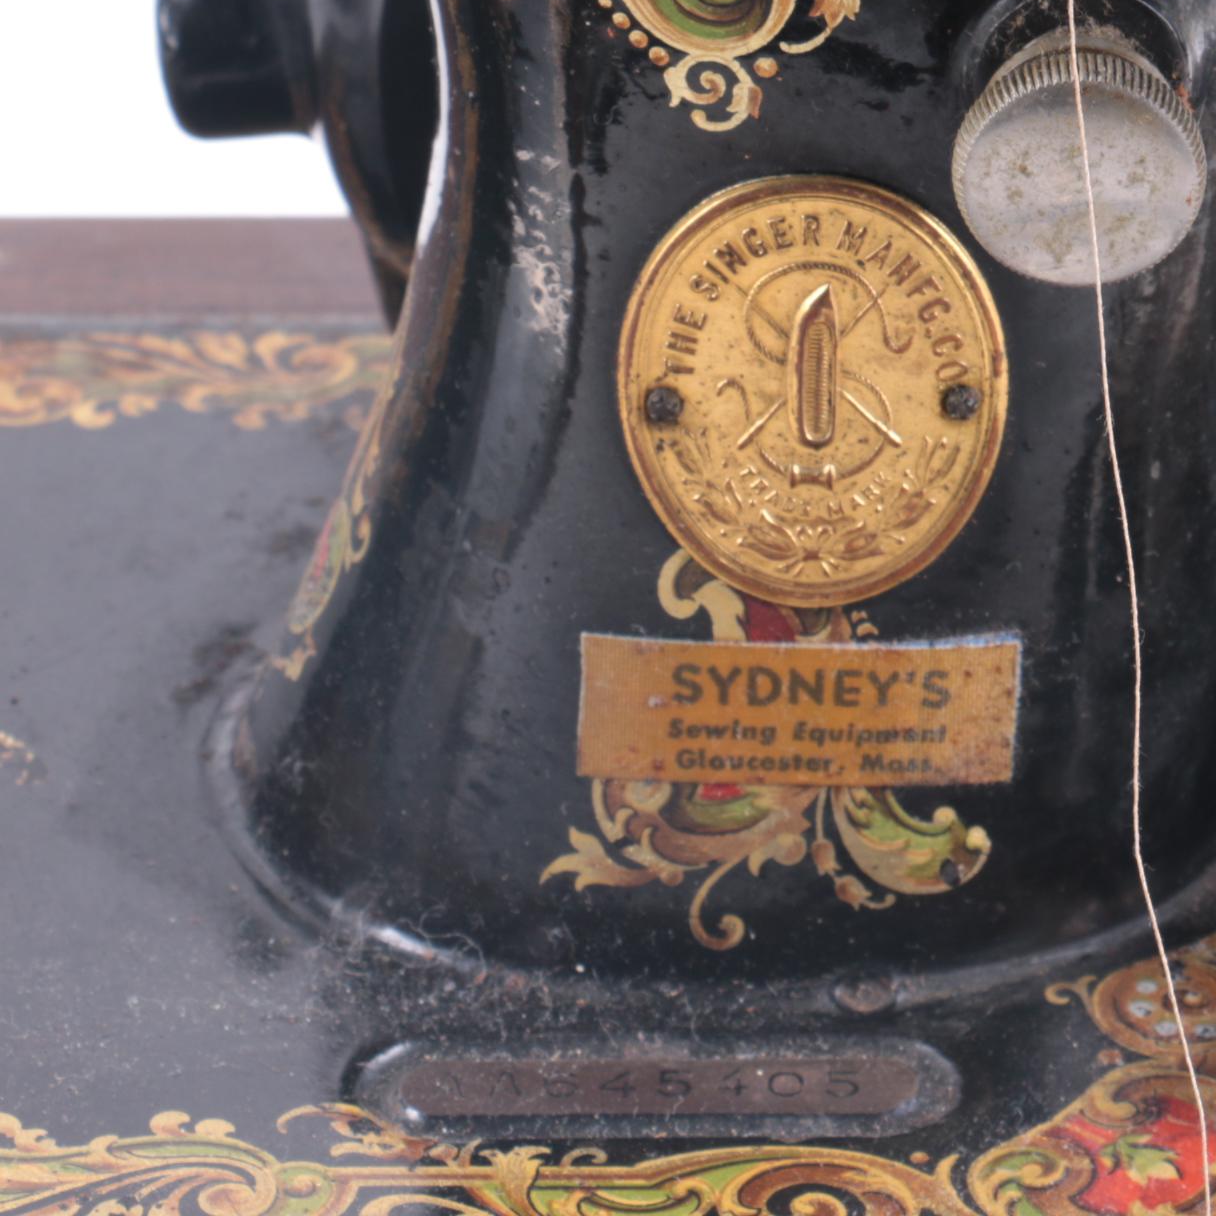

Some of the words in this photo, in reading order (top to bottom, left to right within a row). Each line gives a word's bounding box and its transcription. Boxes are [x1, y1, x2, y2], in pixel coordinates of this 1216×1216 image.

[663, 304, 708, 377] THE
[690, 214, 821, 303] SINGER
[671, 663, 951, 710] SYDNEY'S
[668, 718, 777, 746] Sewing
[791, 720, 947, 747] Equipment
